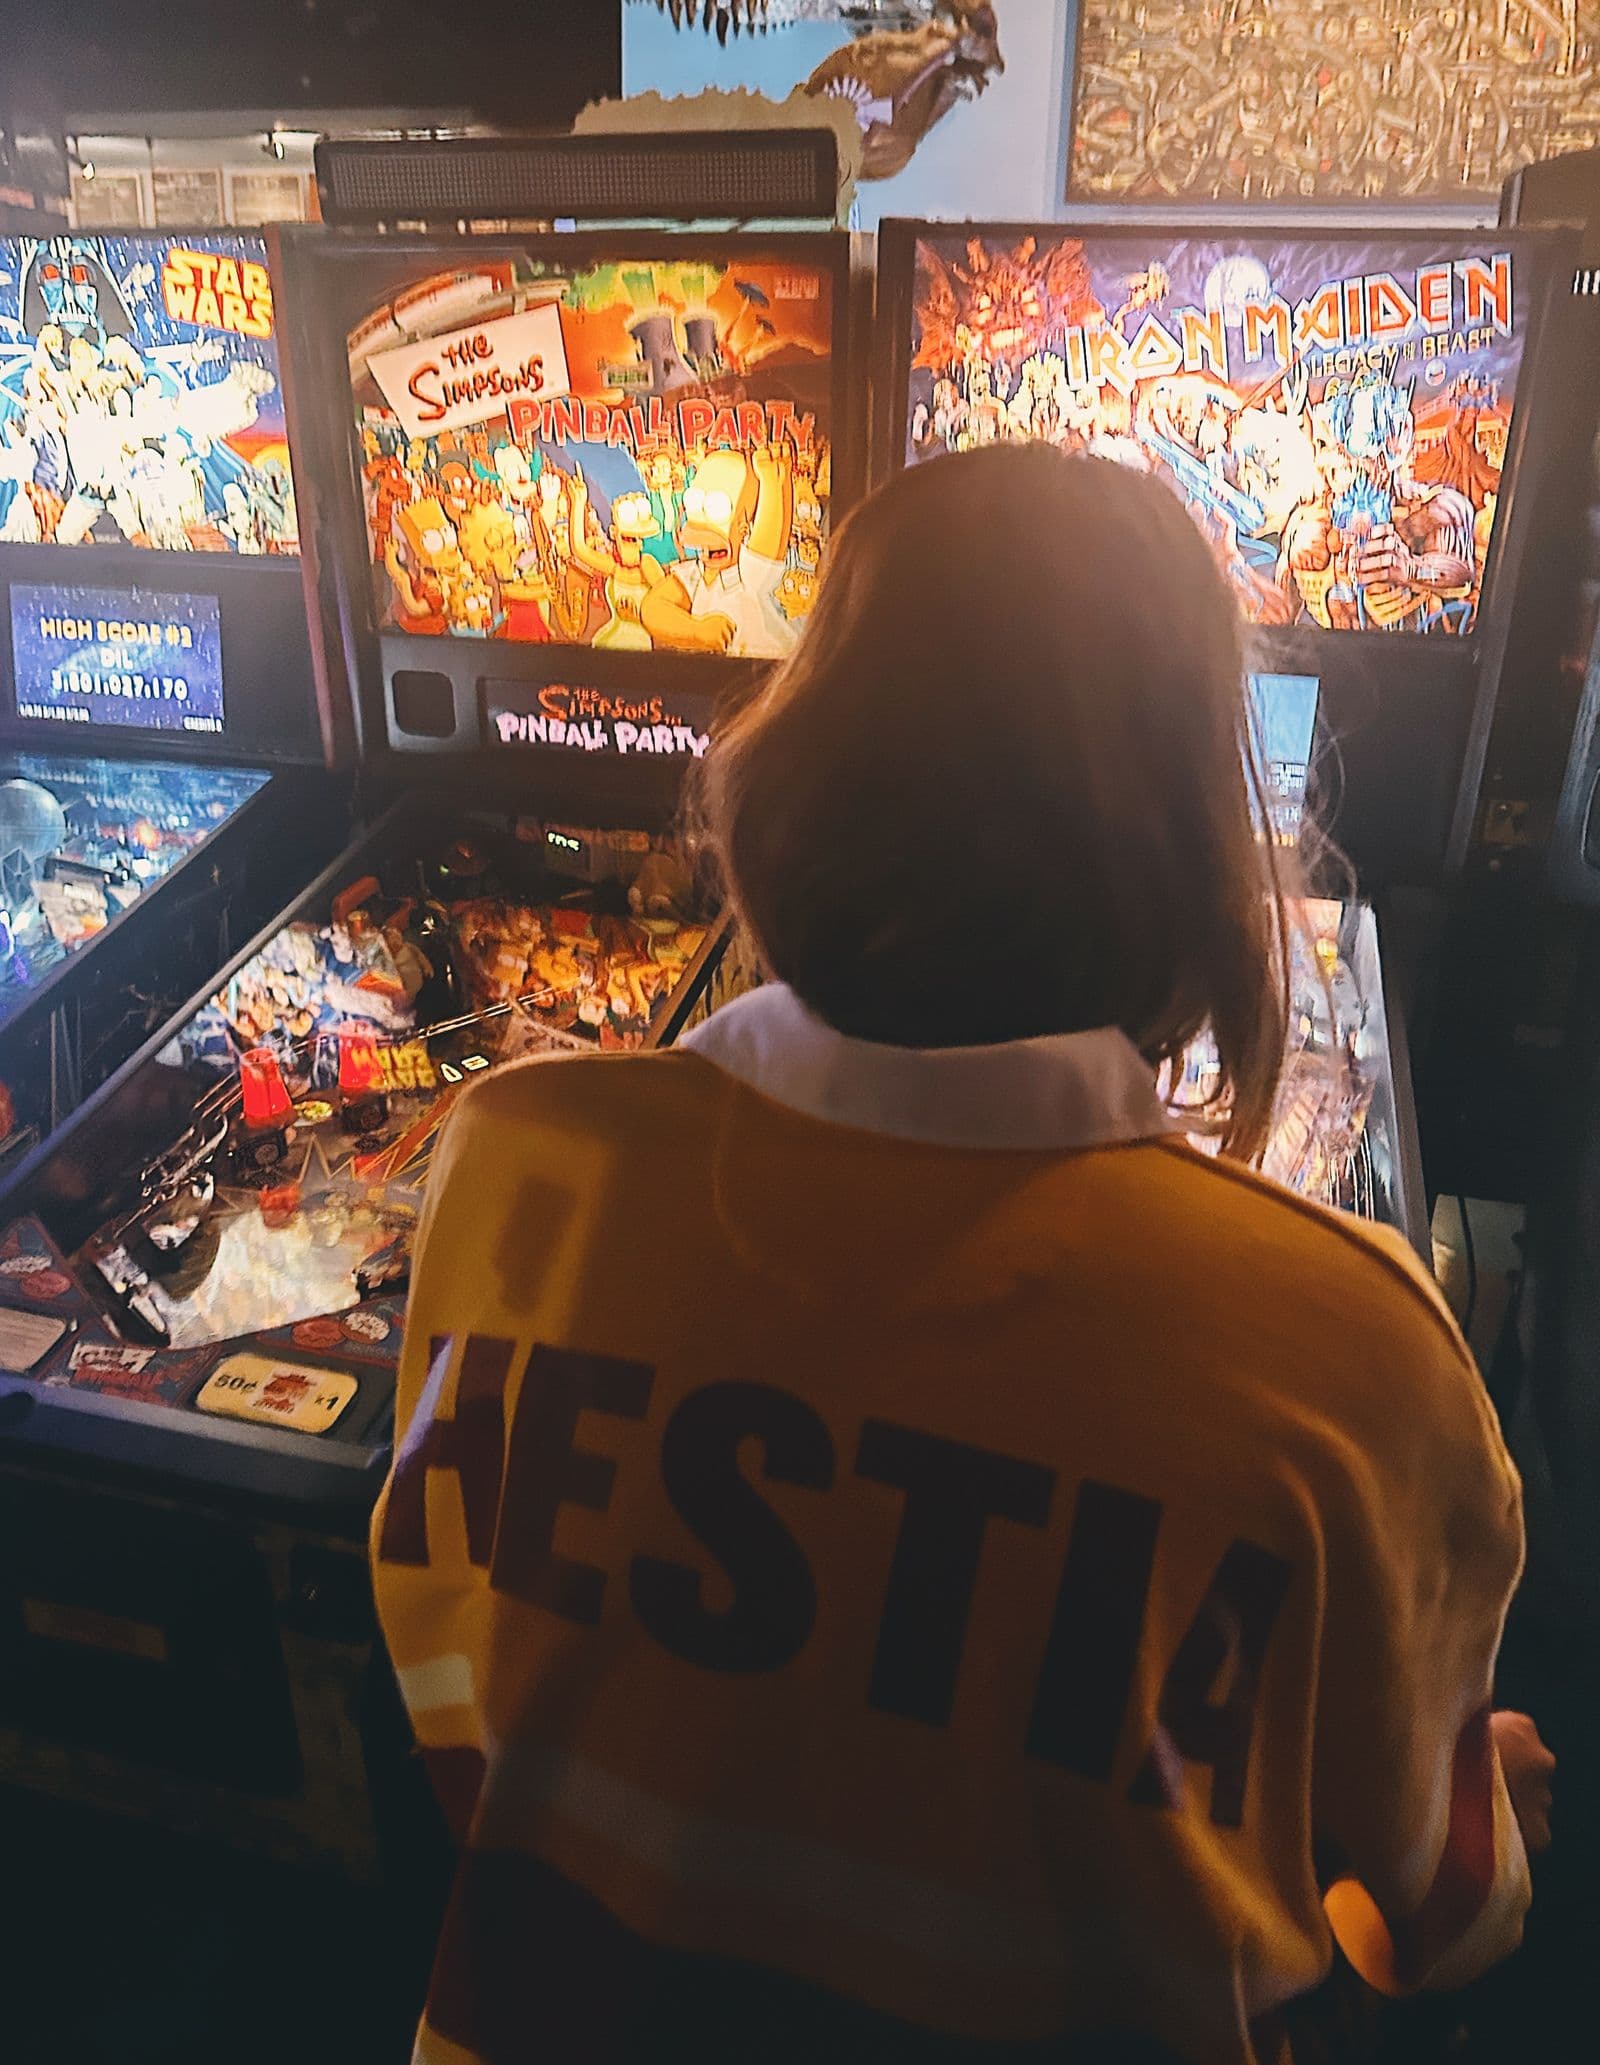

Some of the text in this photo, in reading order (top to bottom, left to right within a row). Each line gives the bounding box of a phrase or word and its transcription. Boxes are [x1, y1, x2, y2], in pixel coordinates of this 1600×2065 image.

[164, 248, 271, 302] STAR
[165, 283, 272, 336] WARS
[1065, 252, 1513, 392] IRON MAIDEN
[1310, 343, 1399, 377] LEGACY
[1423, 328, 1495, 360] BEAST
[506, 397, 816, 451] PINBALL PARTY
[40, 617, 93, 641] HIGH
[97, 620, 162, 646] SCORE
[496, 712, 710, 758] PINBALL PARTY
[215, 1374, 258, 1394] 50¢
[380, 1334, 1295, 1828] HESTIA
